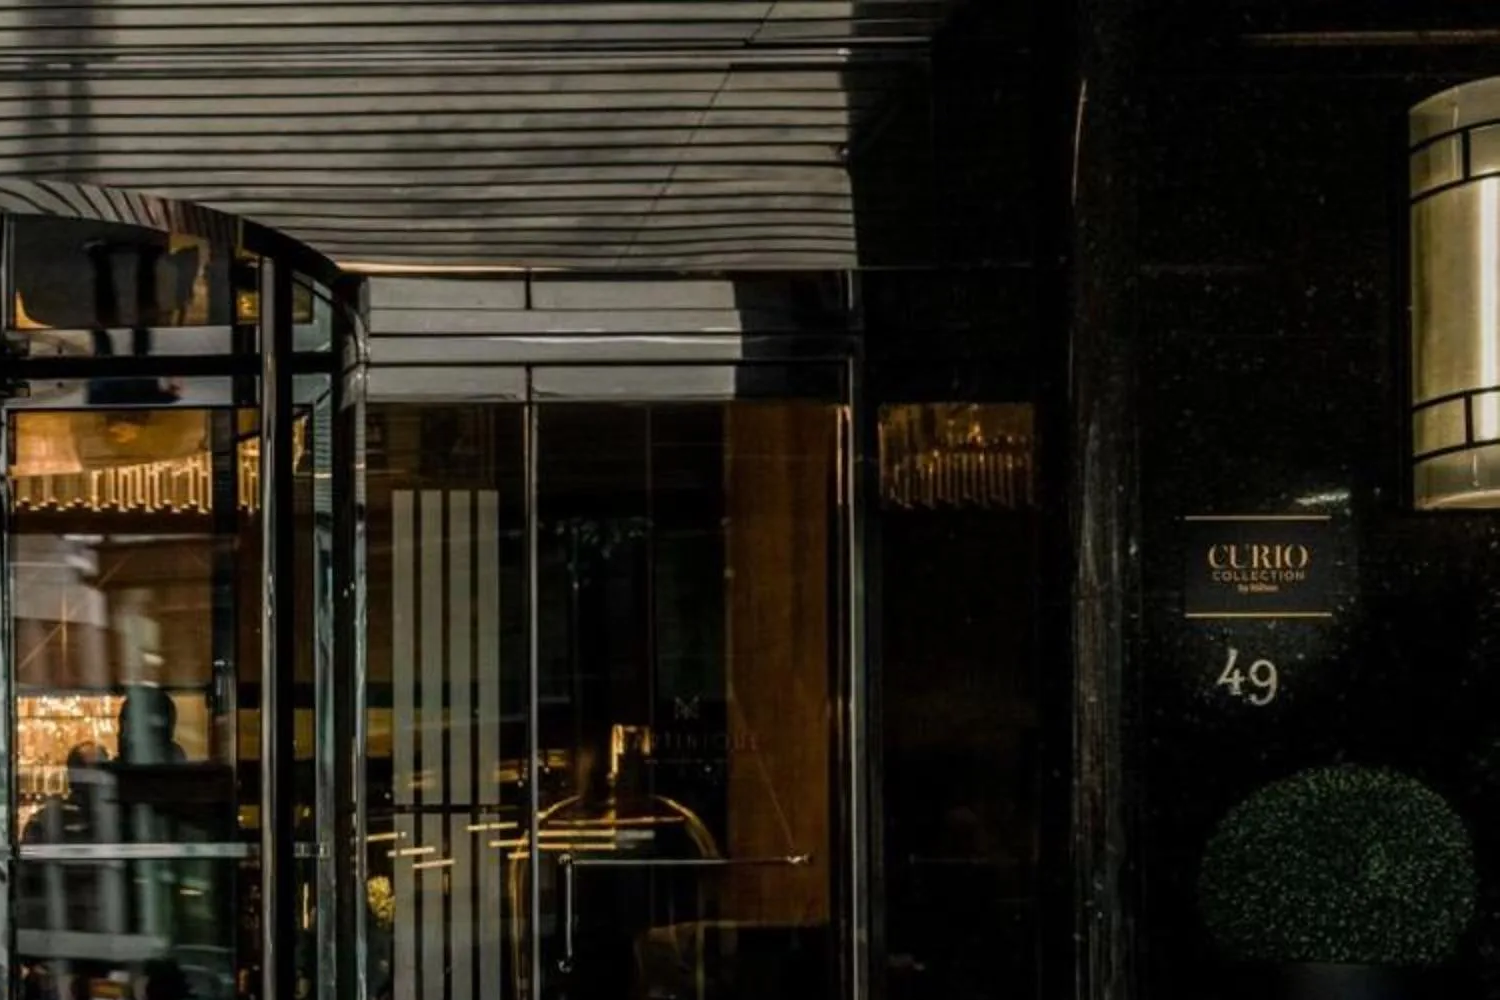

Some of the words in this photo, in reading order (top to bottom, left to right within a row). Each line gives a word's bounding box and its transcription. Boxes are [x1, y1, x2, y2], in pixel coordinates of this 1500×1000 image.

[1208, 544, 1308, 569] CURIO
[1211, 570, 1305, 582] COLLECTION
[1217, 649, 1277, 706] 49
